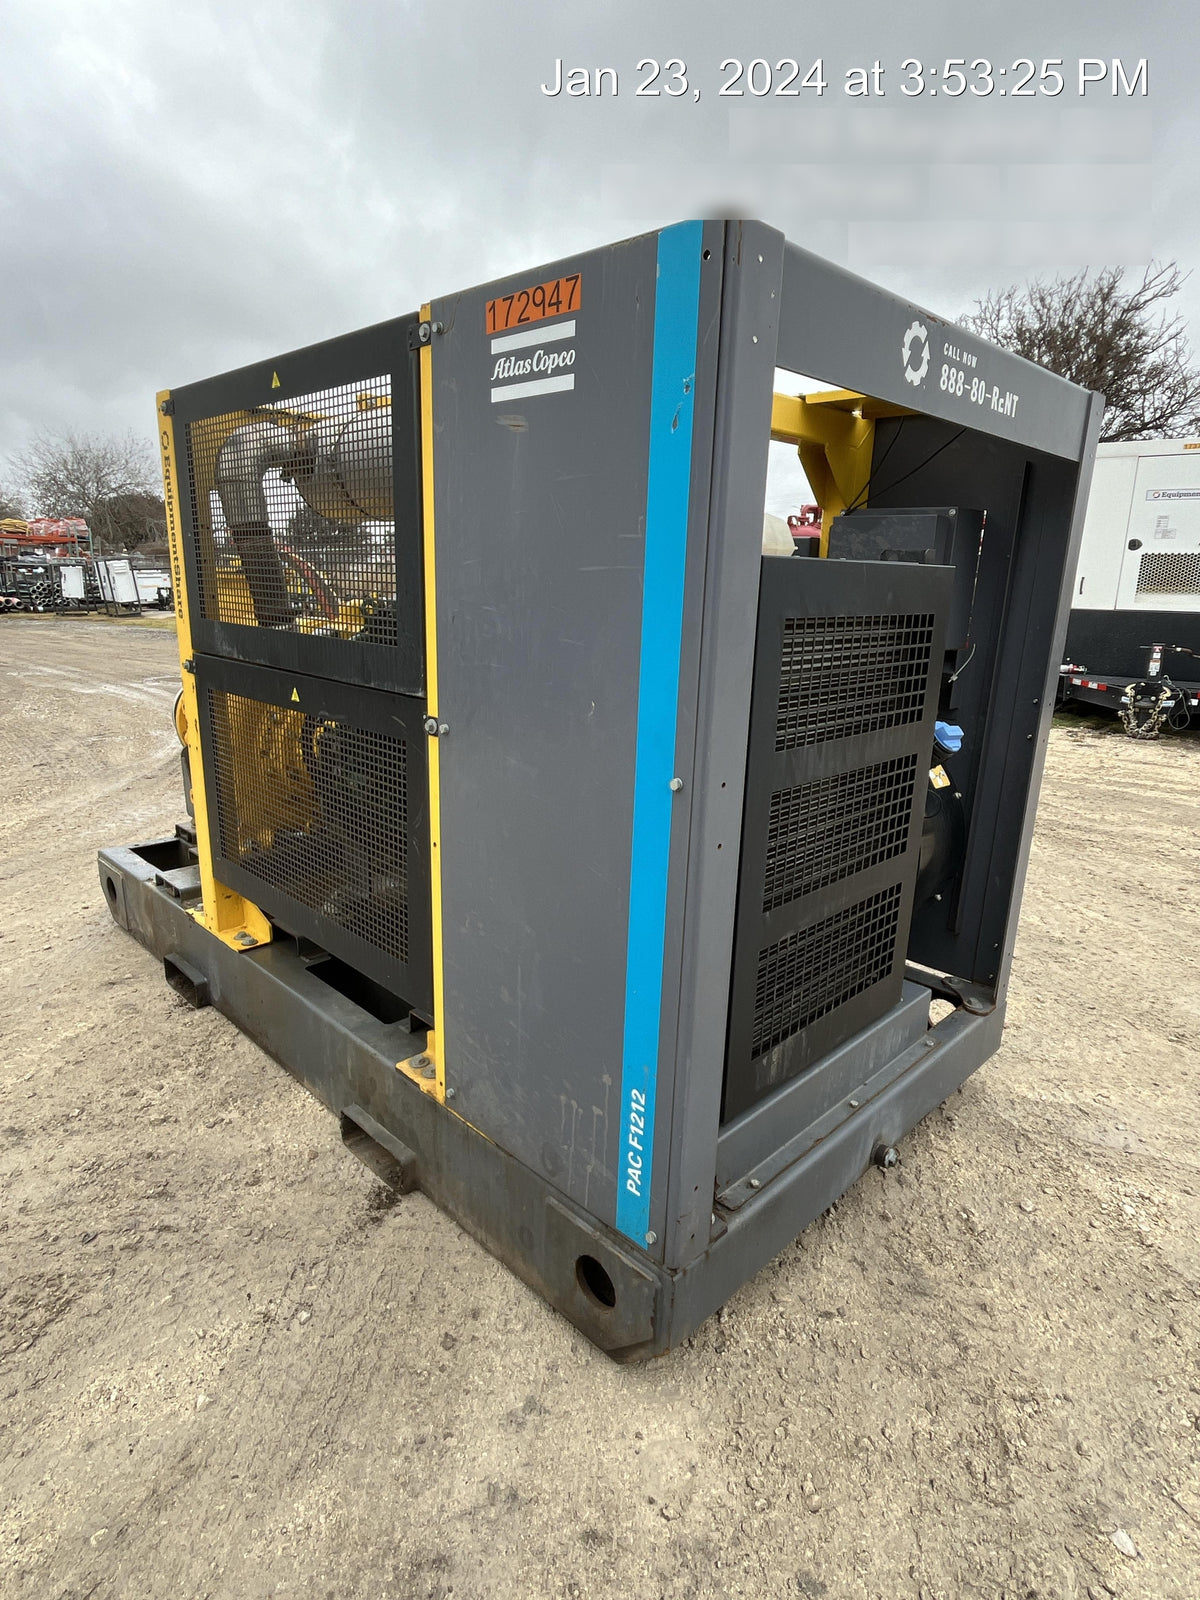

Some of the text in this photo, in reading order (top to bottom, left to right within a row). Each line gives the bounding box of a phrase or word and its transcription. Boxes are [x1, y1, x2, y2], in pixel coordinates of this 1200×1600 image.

[488, 274, 580, 331] 172947
[490, 349, 576, 381] Atlas Copco
[943, 342, 978, 369] CALL NOW
[940, 363, 1019, 418] 888-80-ReNT
[164, 455, 184, 619] EquipmentShare
[626, 1088, 646, 1197] PAC F1212
